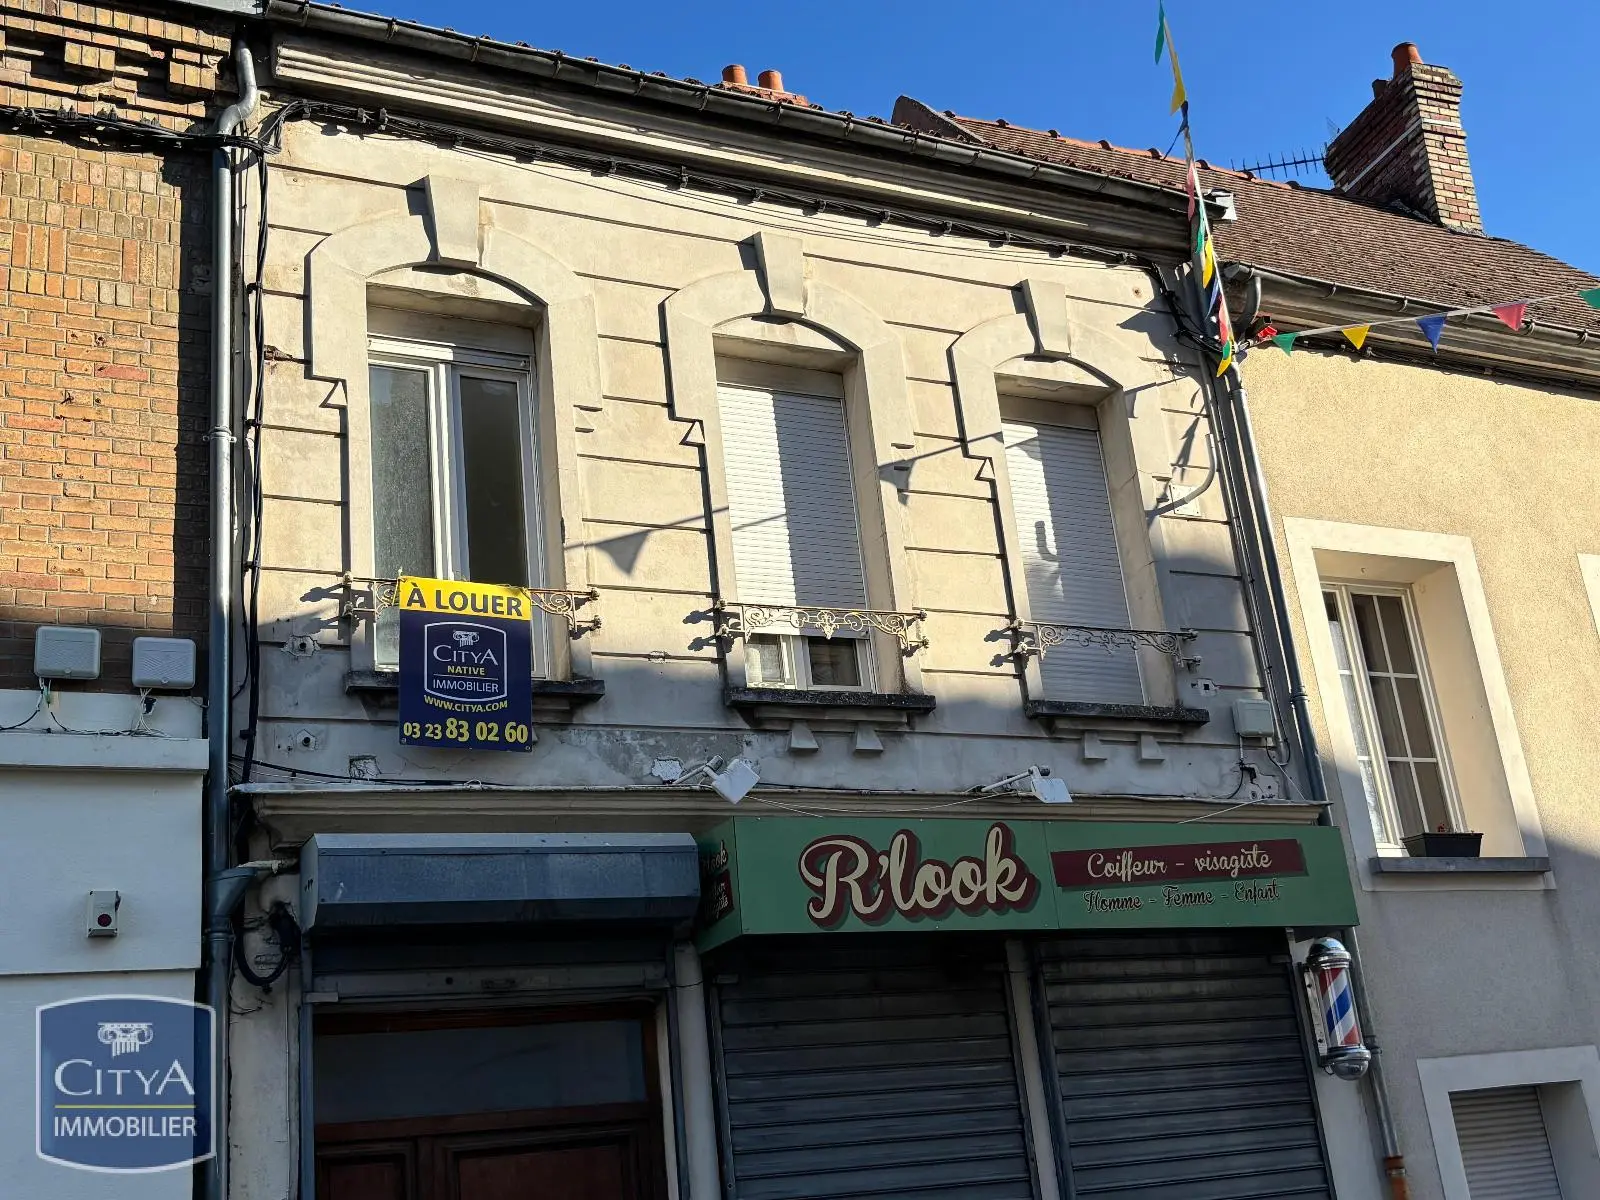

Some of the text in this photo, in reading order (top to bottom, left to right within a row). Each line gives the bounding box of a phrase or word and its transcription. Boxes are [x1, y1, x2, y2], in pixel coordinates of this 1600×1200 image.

[406, 582, 523, 617] À LOUER
[432, 678, 499, 693] IMMOBILIER
[447, 665, 486, 676] NATIVE
[423, 694, 508, 713] WWW.CITYA.COM
[403, 717, 529, 744] 03 23 83 02 60
[799, 823, 1034, 923] R'look
[1087, 850, 1168, 882] Coiffeur
[1194, 844, 1273, 878] visagiste
[1083, 890, 1144, 913] Homme
[1162, 885, 1215, 908] Femme
[1233, 878, 1281, 905] Enfant
